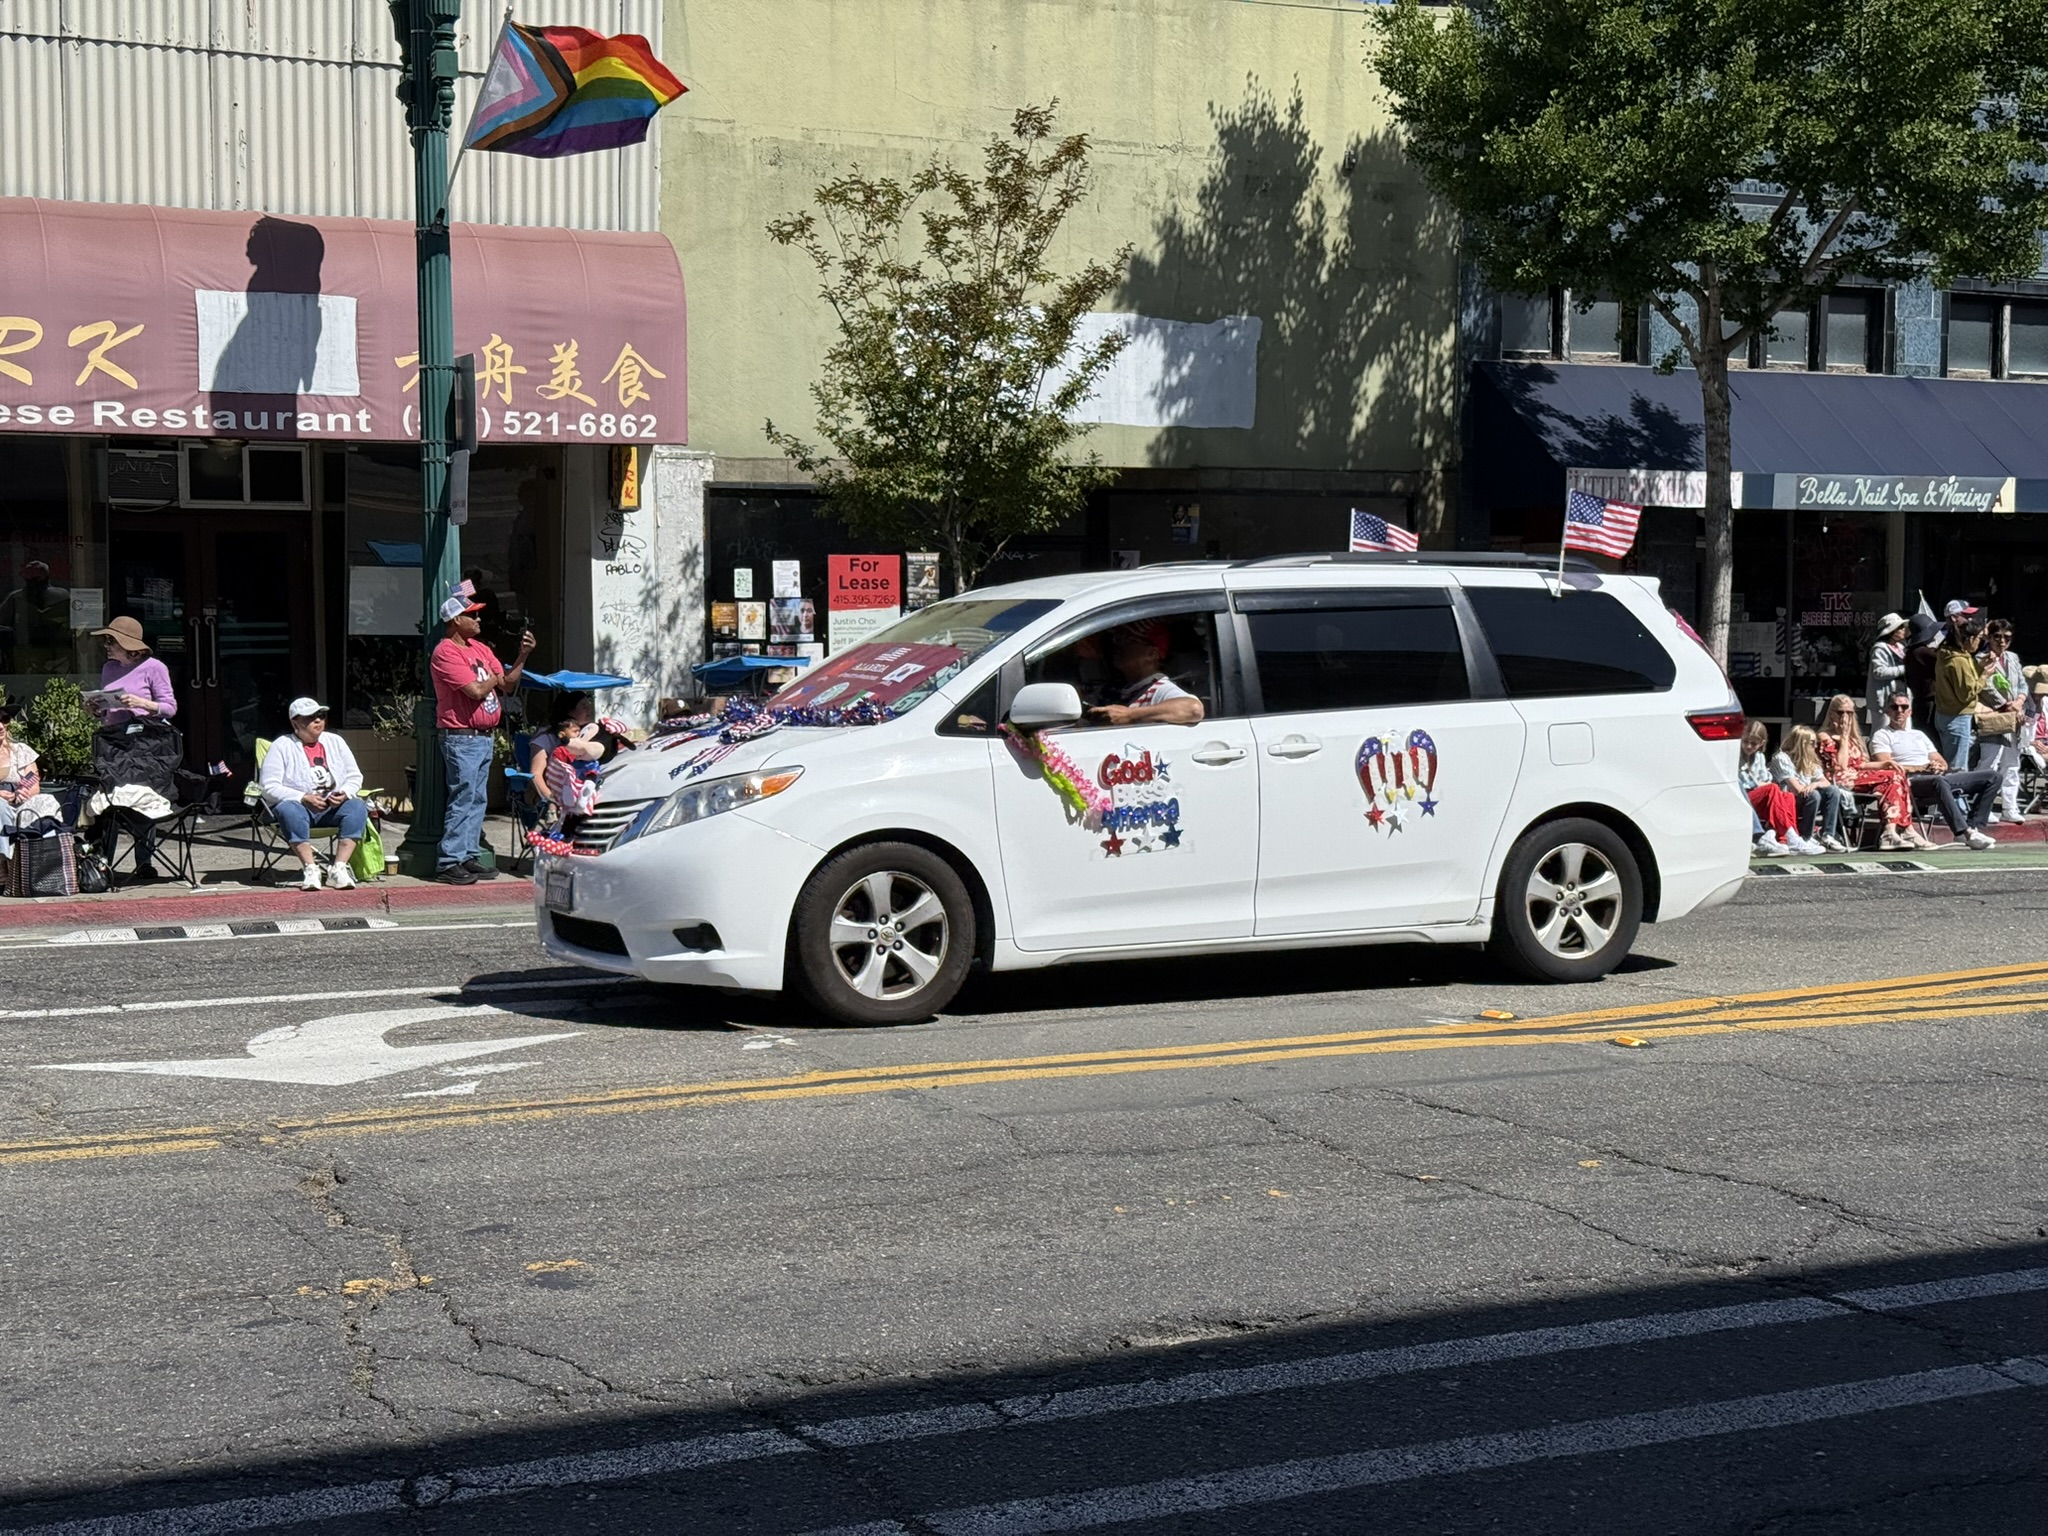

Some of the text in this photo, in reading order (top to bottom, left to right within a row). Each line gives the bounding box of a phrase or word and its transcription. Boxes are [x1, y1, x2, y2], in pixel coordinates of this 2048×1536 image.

[93, 400, 372, 433] Restaurant
[503, 411, 657, 438] 521-6862
[1799, 476, 1992, 512] Bella Nail Spa & Waxing
[605, 563, 642, 576] PABLO
[849, 557, 880, 573] For
[839, 574, 890, 590] Lease
[833, 594, 898, 605] 415.395.7262
[1820, 591, 1852, 611] TK
[832, 617, 877, 626] Justin Choi
[1801, 611, 1832, 627] BARBER
[1832, 611, 1854, 627] SHOP
[832, 637, 847, 646] Jeff
[1100, 750, 1153, 786] God
